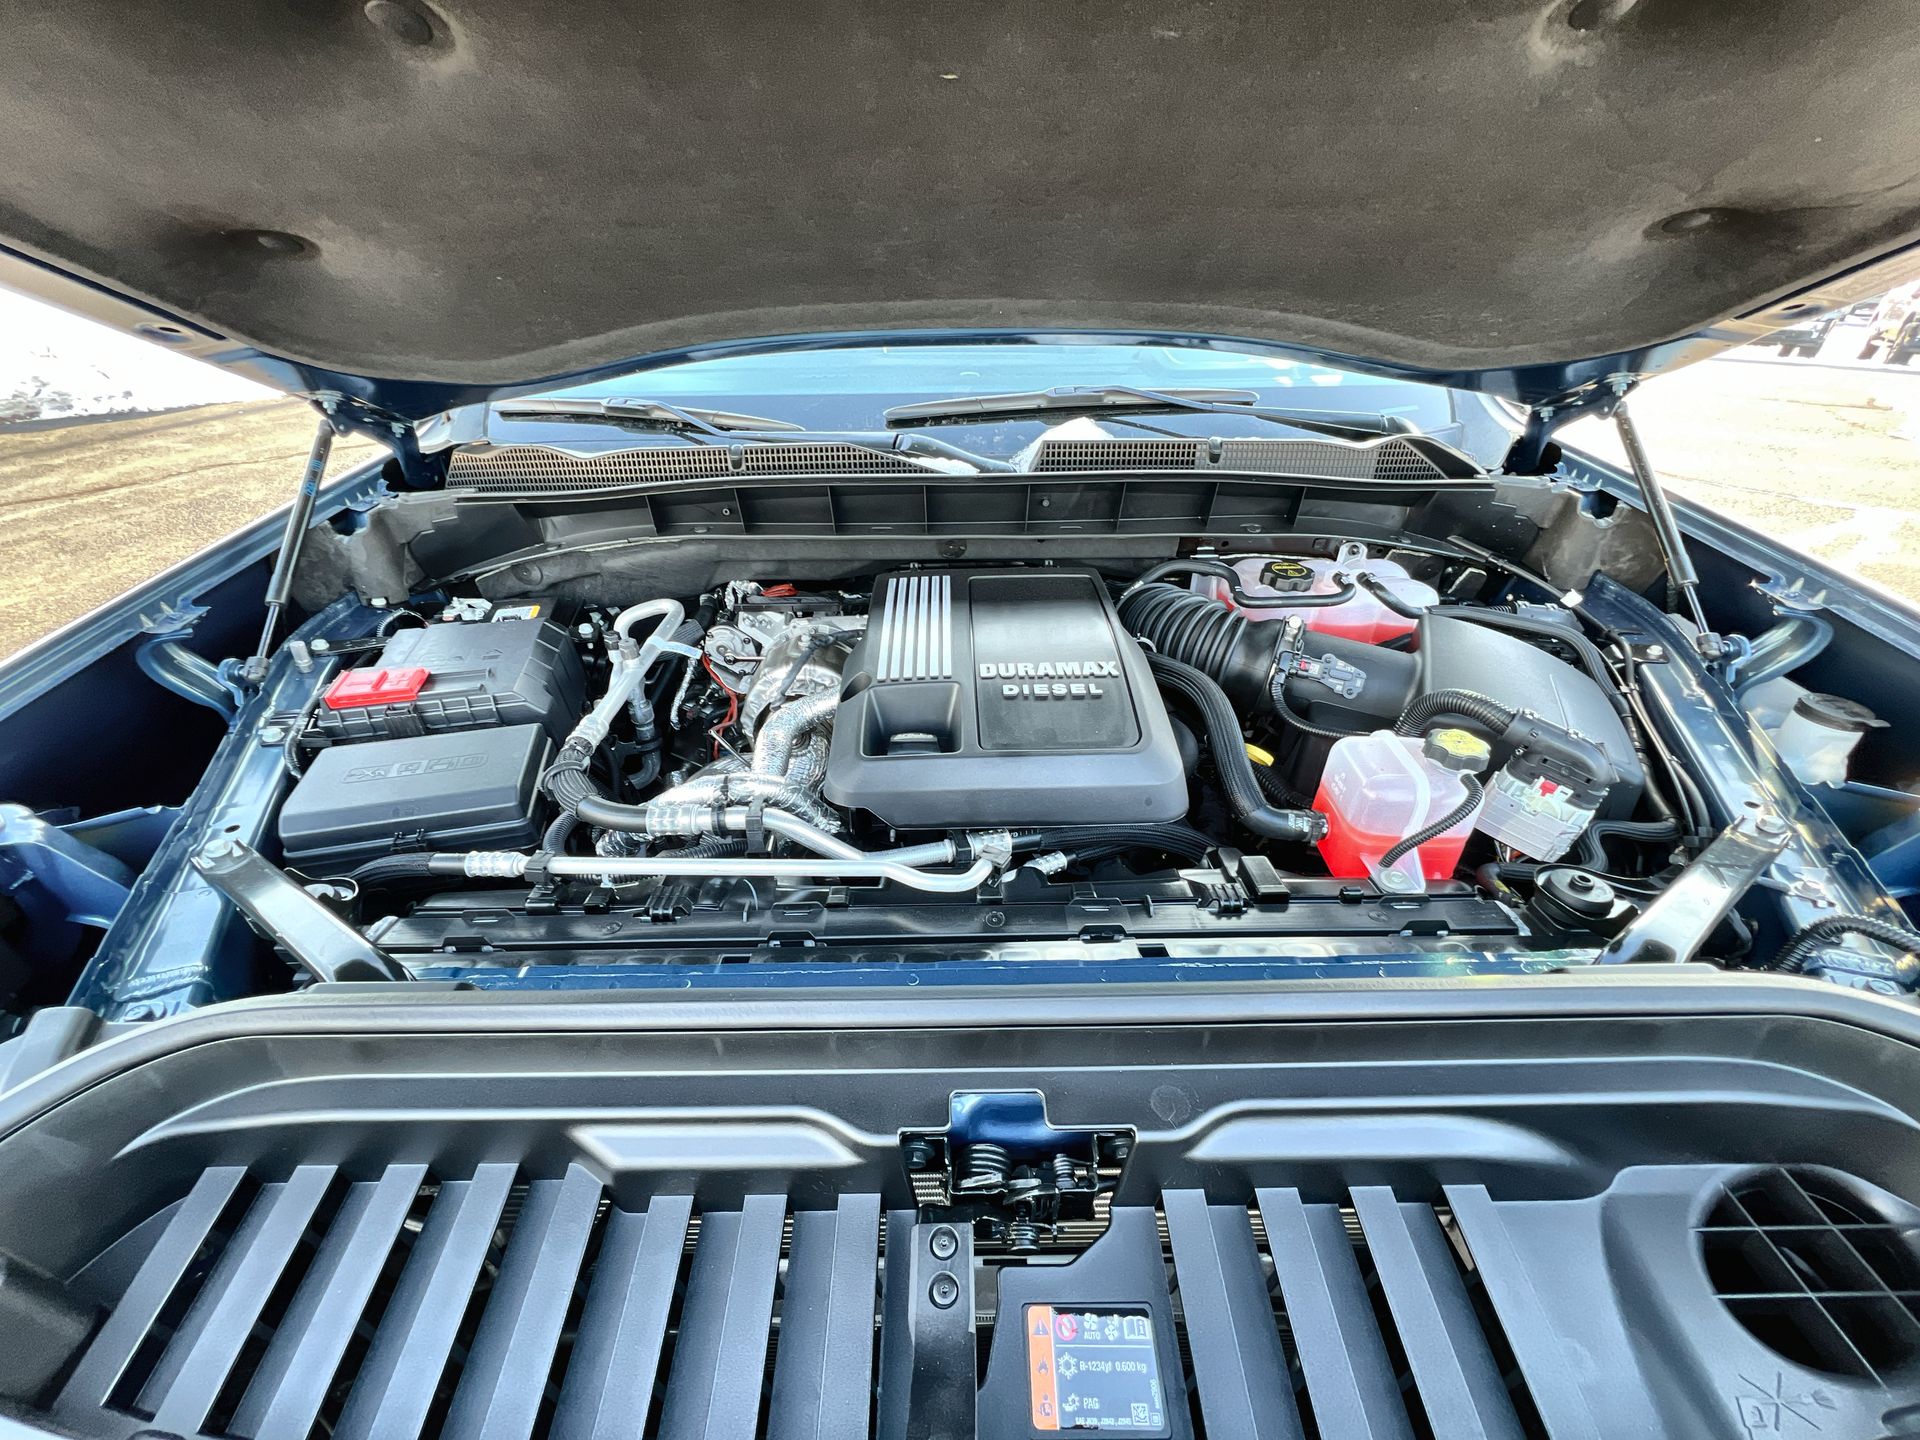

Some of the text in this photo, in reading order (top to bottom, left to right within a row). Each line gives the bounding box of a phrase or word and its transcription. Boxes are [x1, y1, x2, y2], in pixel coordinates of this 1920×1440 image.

[979, 661, 1120, 679] DURAMAX
[1002, 683, 1104, 699] DIESEL
[1084, 1331, 1101, 1340] AUTO
[1137, 1361, 1147, 1374] kg
[1083, 1397, 1100, 1409] PAG
